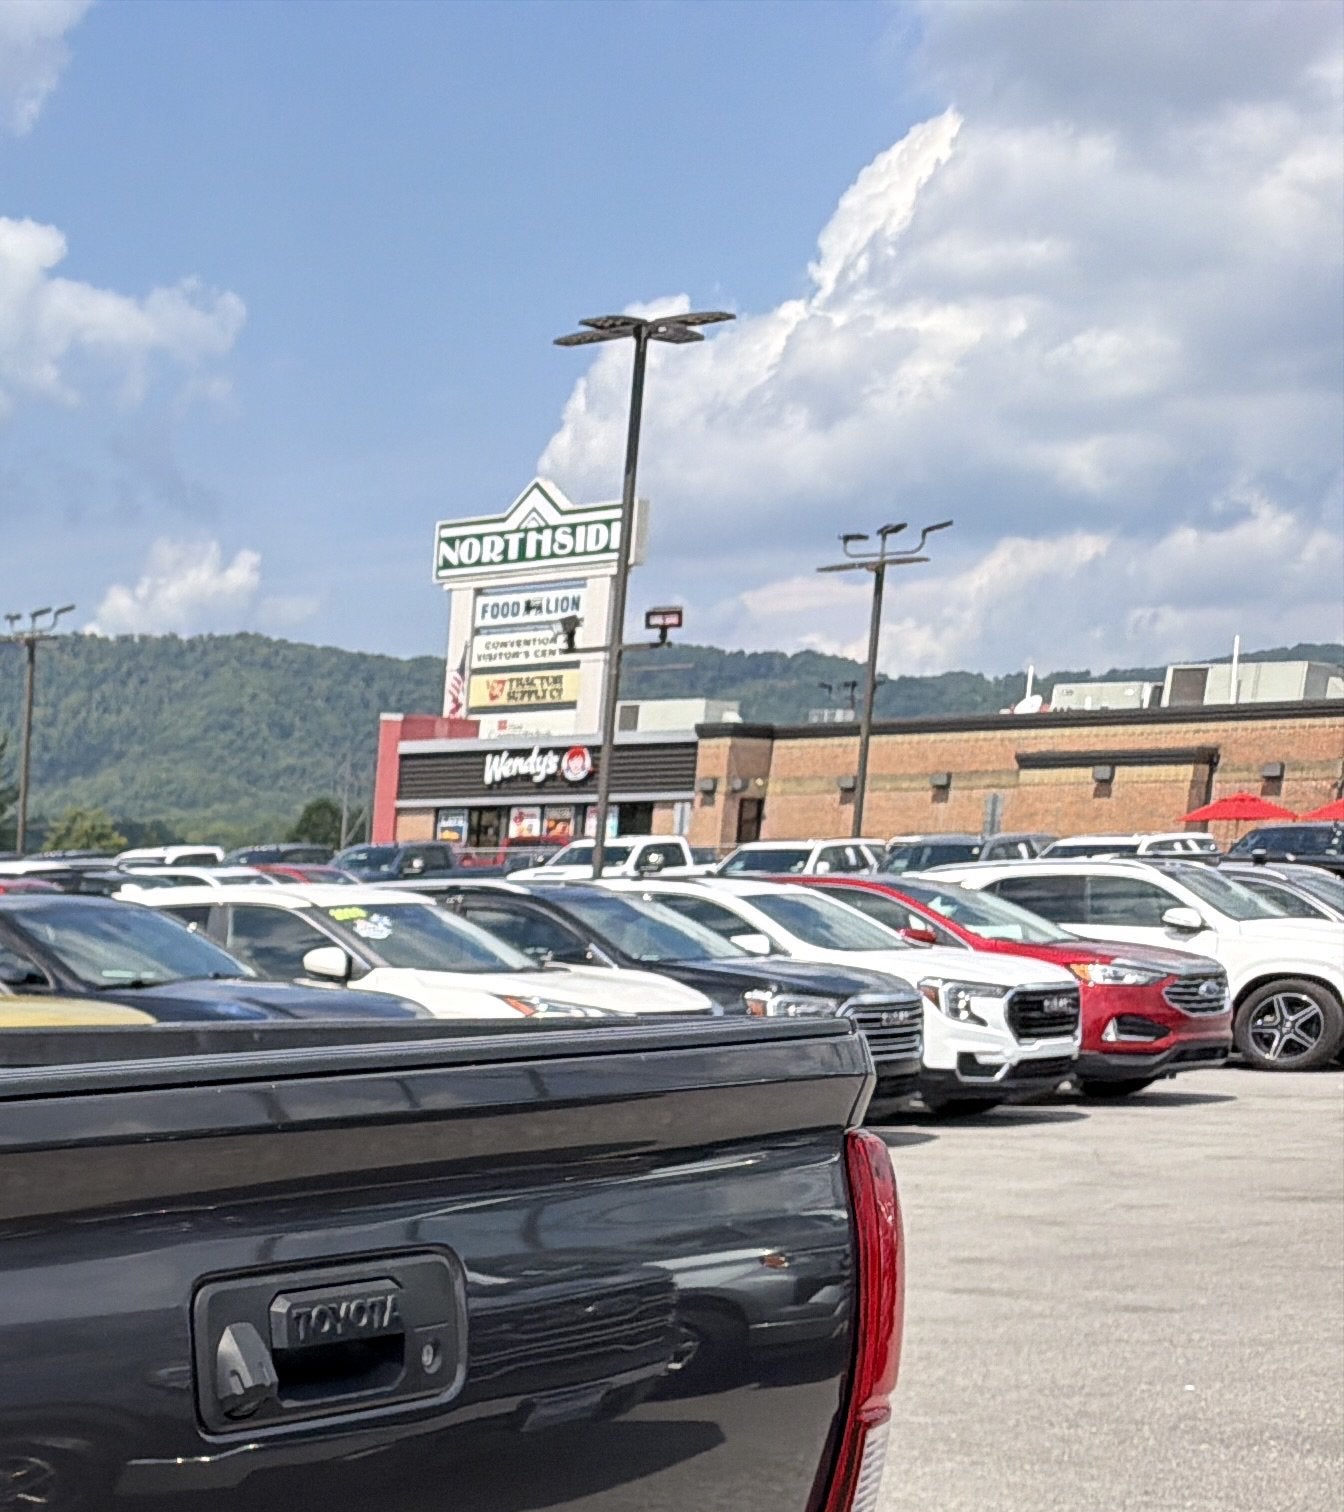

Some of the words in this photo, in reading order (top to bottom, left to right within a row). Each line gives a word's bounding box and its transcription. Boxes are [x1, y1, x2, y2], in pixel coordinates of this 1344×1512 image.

[481, 601, 520, 620] FOOD
[546, 595, 581, 615] LION
[485, 636, 557, 650] CONVENTION
[483, 745, 559, 785] Wendy's
[292, 1294, 399, 1340] TOYOTA
